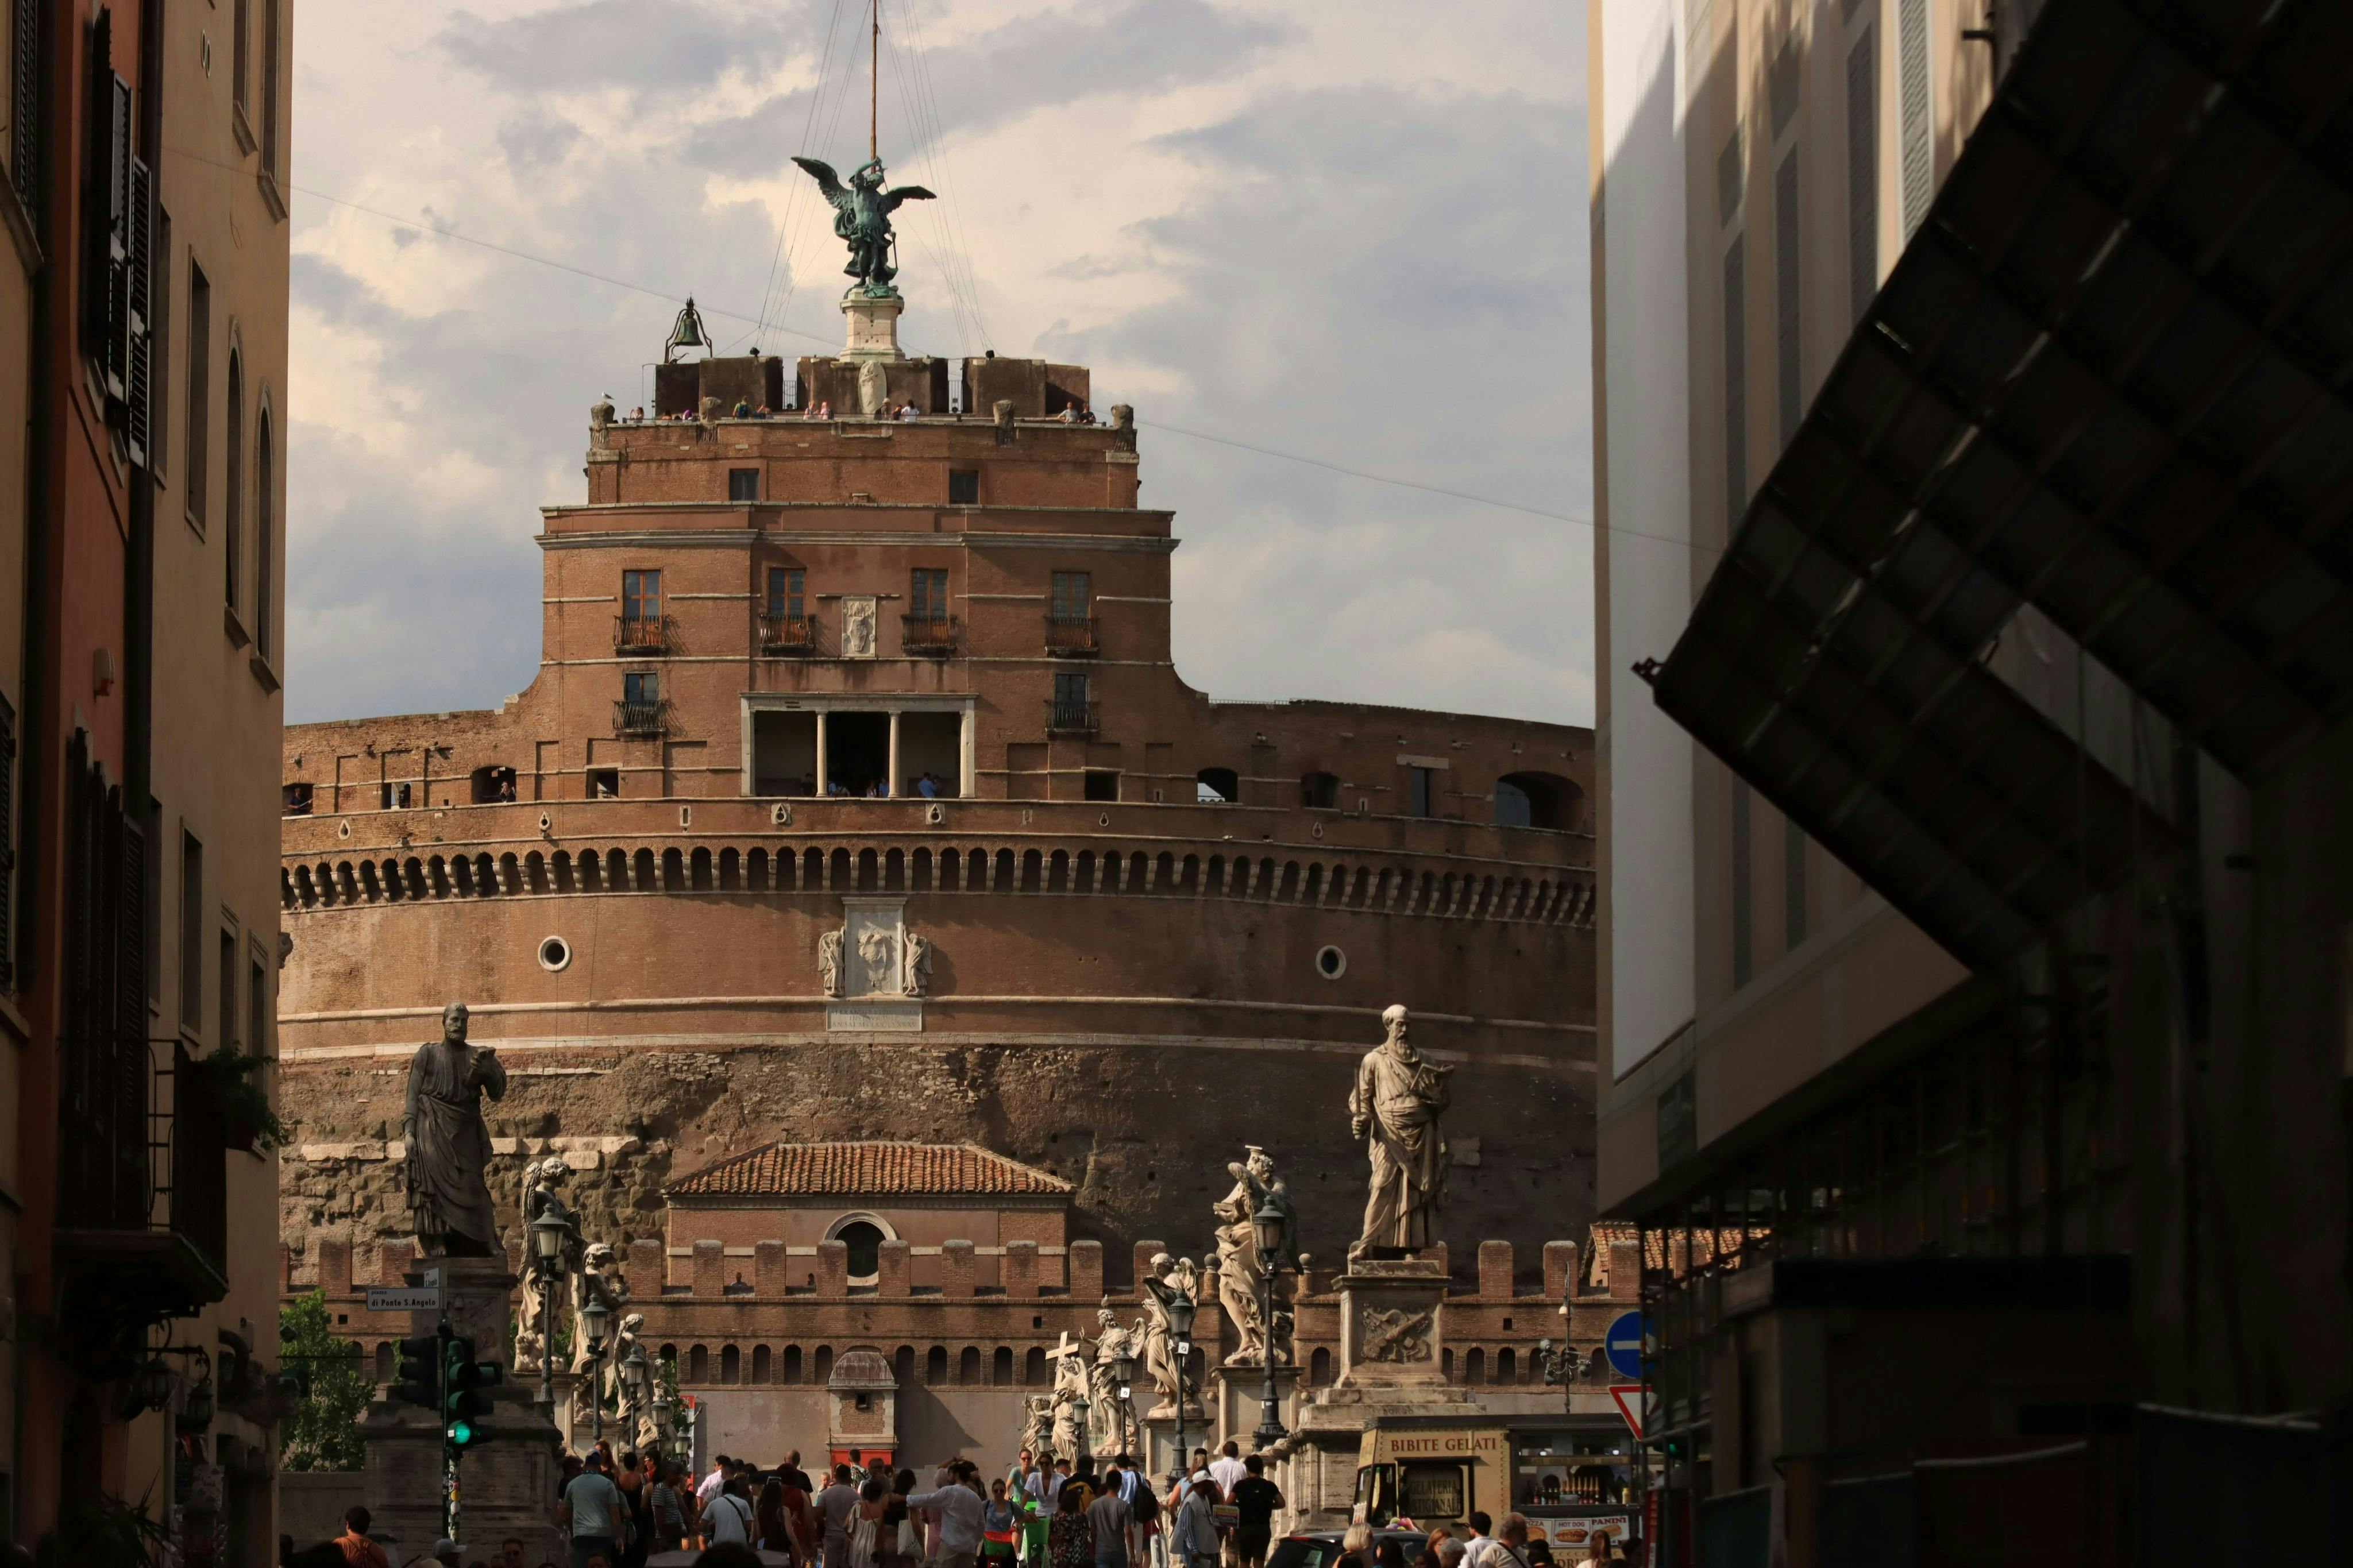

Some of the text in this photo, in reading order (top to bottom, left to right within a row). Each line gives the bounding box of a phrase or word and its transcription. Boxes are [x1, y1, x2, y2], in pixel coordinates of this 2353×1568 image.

[1391, 1438, 1496, 1451] BIBITE GELATI
[1410, 1479, 1456, 1494] GELATERIA
[1591, 1517, 1627, 1525] PANINI
